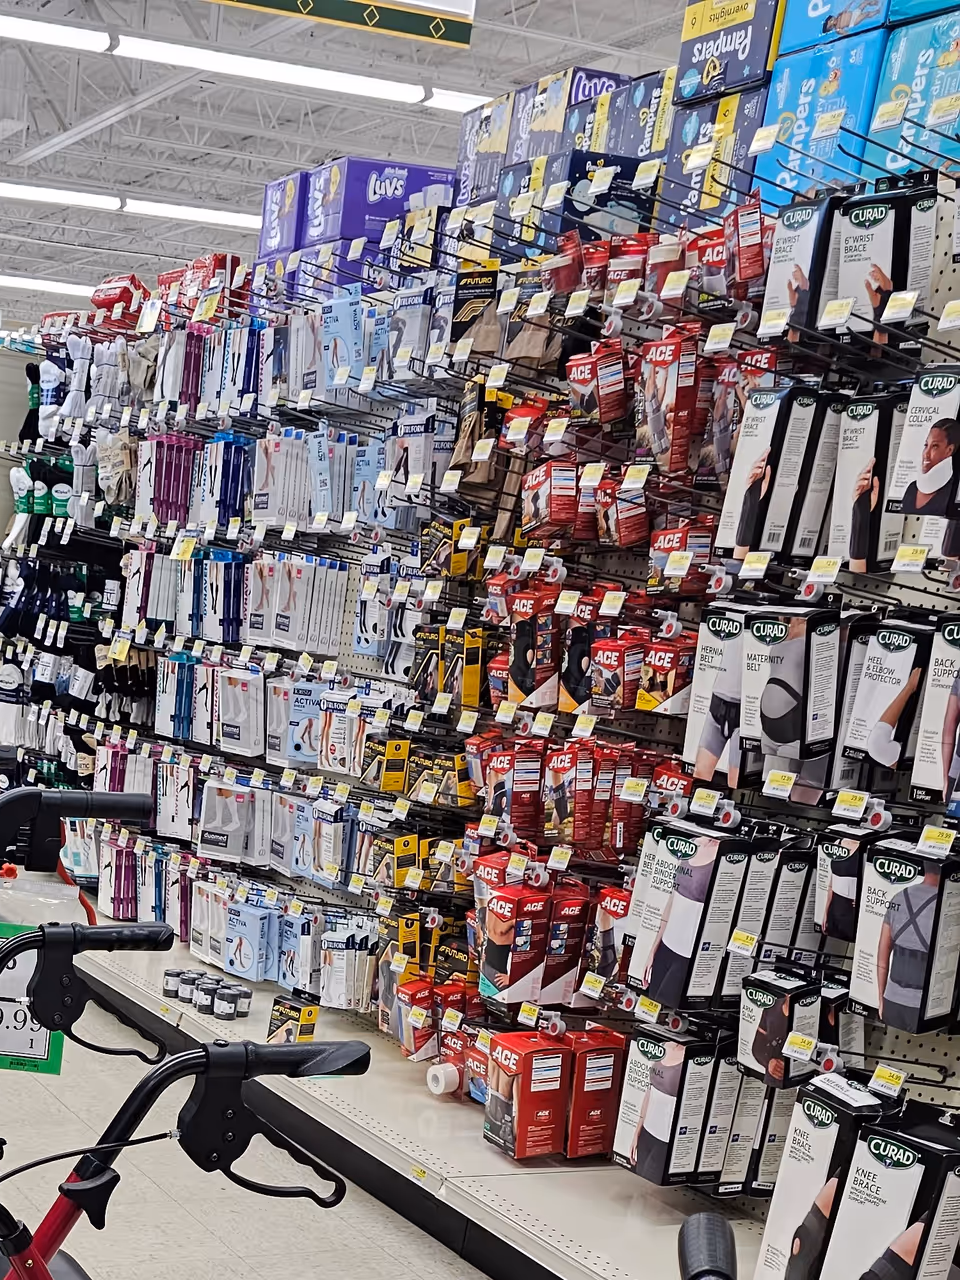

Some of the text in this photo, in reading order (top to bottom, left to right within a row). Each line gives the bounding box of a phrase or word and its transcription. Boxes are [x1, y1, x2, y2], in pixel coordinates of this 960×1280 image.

[692, 25, 753, 64] Pampers
[886, 47, 935, 170] Pampers
[637, 87, 662, 157] Pampers
[775, 76, 816, 191] Pampers
[916, 200, 935, 211] CURAD
[782, 208, 813, 226] CURAD
[851, 206, 886, 225] CURAD
[852, 233, 875, 244] WRIST
[774, 245, 794, 255] BRACE
[843, 243, 868, 254] BRACE
[466, 277, 493, 285] FUTURO
[607, 269, 629, 280] ACE
[645, 345, 676, 361] ACE
[740, 353, 771, 370] ACE
[569, 364, 592, 381] ACE
[920, 376, 957, 391] CURAD
[751, 393, 776, 405] CURAD
[796, 397, 814, 405] CURAD
[848, 404, 873, 417] CURAD
[909, 406, 940, 415] CERVICAL
[908, 415, 933, 424] COLLAR
[842, 435, 859, 443] BRACE
[524, 466, 548, 489] ACE
[653, 533, 683, 549] ACE
[487, 585, 502, 595] ACE
[512, 599, 535, 613] ACE
[542, 598, 556, 606] ACE
[572, 605, 593, 619] ACE
[708, 618, 740, 634] CURAD
[752, 622, 786, 638] CURAD
[816, 623, 837, 635] CURAD
[878, 632, 911, 647] CURAD
[700, 645, 724, 656] HERNIA
[594, 650, 620, 666] ACE
[645, 650, 674, 667] ACE
[699, 654, 714, 664] BELT
[746, 653, 785, 665] MATERNITY
[867, 656, 883, 665] HEEL
[934, 657, 956, 669] BACK
[490, 669, 509, 679] ACE
[746, 662, 761, 672] BELT
[871, 665, 896, 676] ELBOW
[863, 671, 902, 686] PROTECTOR
[294, 697, 321, 707] ACTIVA
[489, 755, 512, 769] ACE
[548, 753, 574, 769] ACE
[656, 774, 688, 793] ACE
[203, 831, 229, 841] duomed
[666, 837, 696, 855] CURAD
[822, 843, 849, 857] CURAD
[726, 854, 745, 863] CURAD
[756, 853, 775, 862] CURAD
[476, 865, 500, 882] ACE
[654, 859, 694, 878] ABDOMINAL
[788, 862, 806, 871] CURAD
[875, 859, 915, 878] CURAD
[653, 867, 677, 881] BINDER
[651, 877, 681, 891] SUPPORT
[867, 886, 888, 899] BACK
[489, 898, 514, 917] ACE
[523, 901, 544, 912] ACE
[561, 906, 582, 915] ACE
[601, 896, 628, 914] ACE
[866, 895, 901, 912] SUPPORT
[444, 946, 468, 962] FUTURO
[398, 991, 410, 1003] ACE
[415, 989, 430, 999] ACE
[448, 993, 462, 1001] ACE
[746, 989, 774, 1005] CURAD
[799, 995, 818, 1006] CURAD
[279, 1006, 300, 1019] FUTURO
[741, 1009, 757, 1022] SLING
[742, 1004, 754, 1014] ARM
[28, 1038, 35, 1049] 1
[444, 1035, 463, 1051] ACE
[638, 1039, 665, 1057] CURAD
[492, 1045, 519, 1070] ACE
[693, 1056, 712, 1064] CURAD
[466, 1057, 487, 1074] ACE
[628, 1059, 665, 1079] ABDOMINAL
[628, 1066, 650, 1080] BINDER
[626, 1073, 653, 1090] SUPPORT
[803, 1101, 833, 1123] CURAD
[793, 1126, 810, 1142] KNEE
[791, 1137, 812, 1153] BRACE
[869, 1139, 914, 1165] CURAD
[855, 1166, 879, 1183] KNEE
[852, 1177, 882, 1196] BRACE
